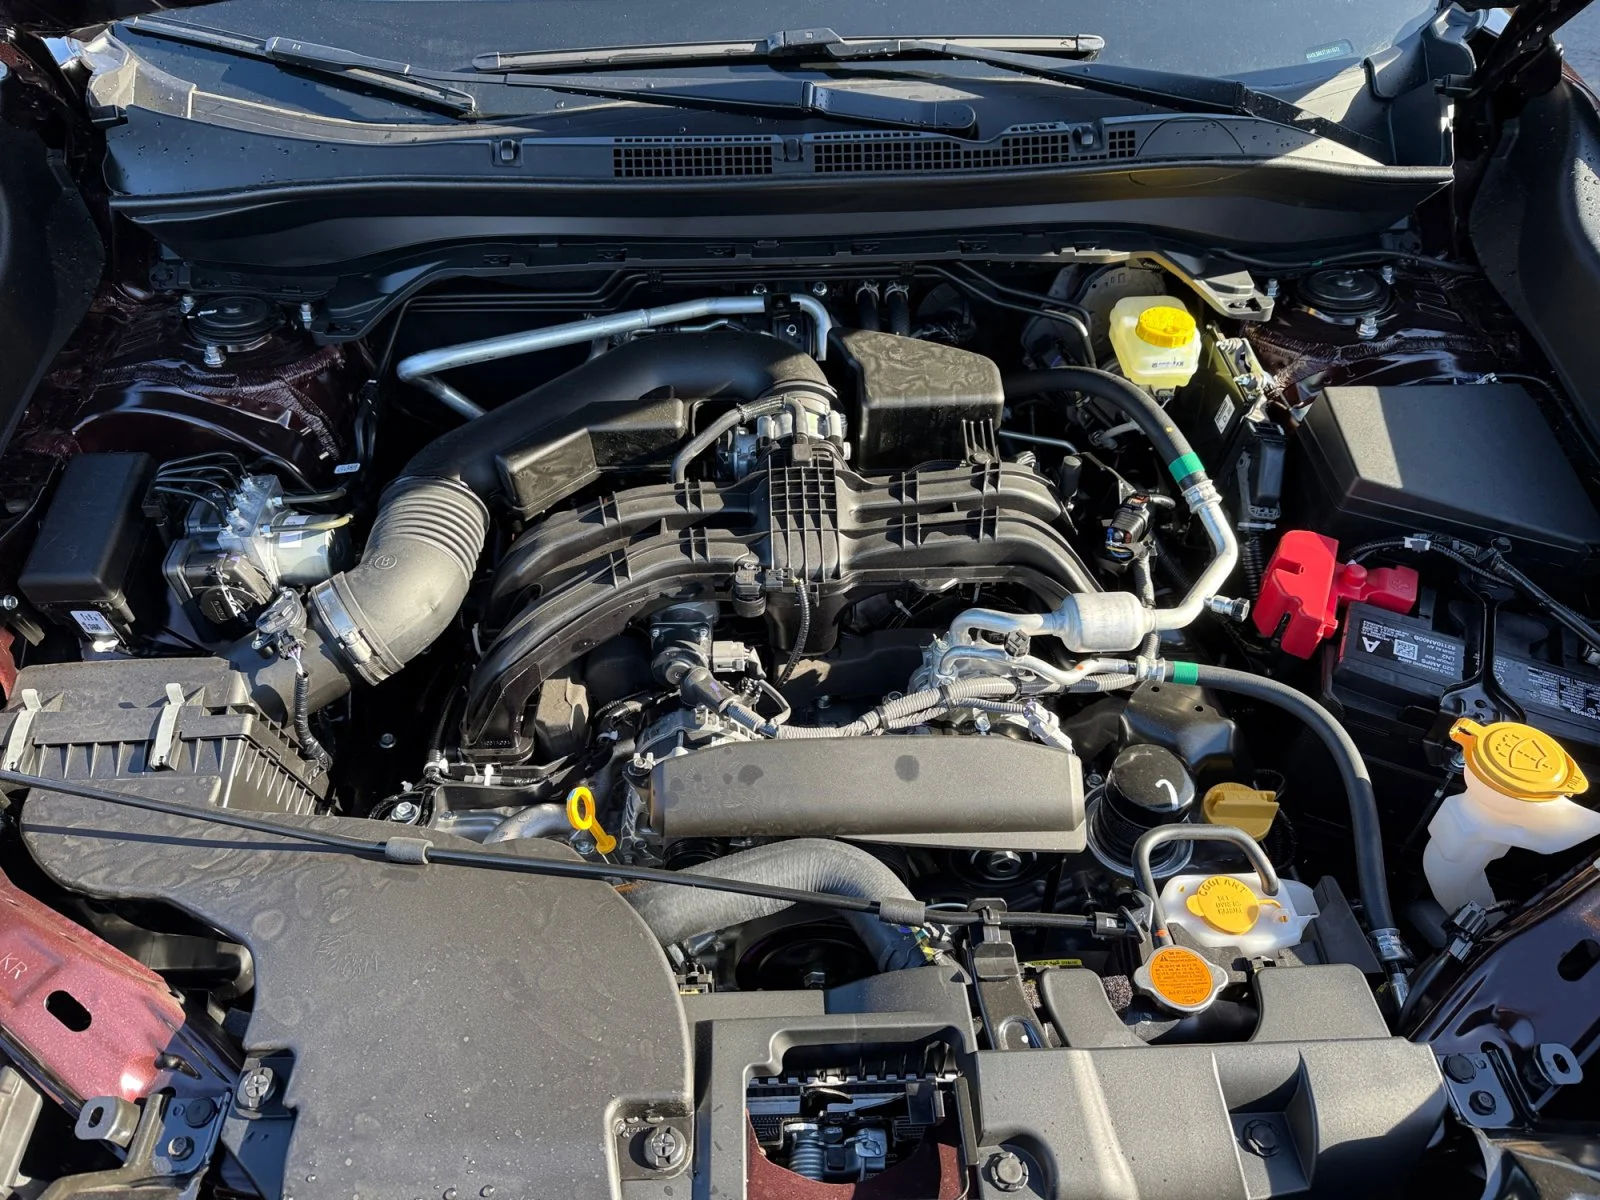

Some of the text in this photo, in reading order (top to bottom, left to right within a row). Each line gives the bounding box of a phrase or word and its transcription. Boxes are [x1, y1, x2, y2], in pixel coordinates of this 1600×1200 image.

[1362, 636, 1381, 653] A
[1421, 658, 1442, 668] AMPS
[1441, 654, 1456, 662] LN2
